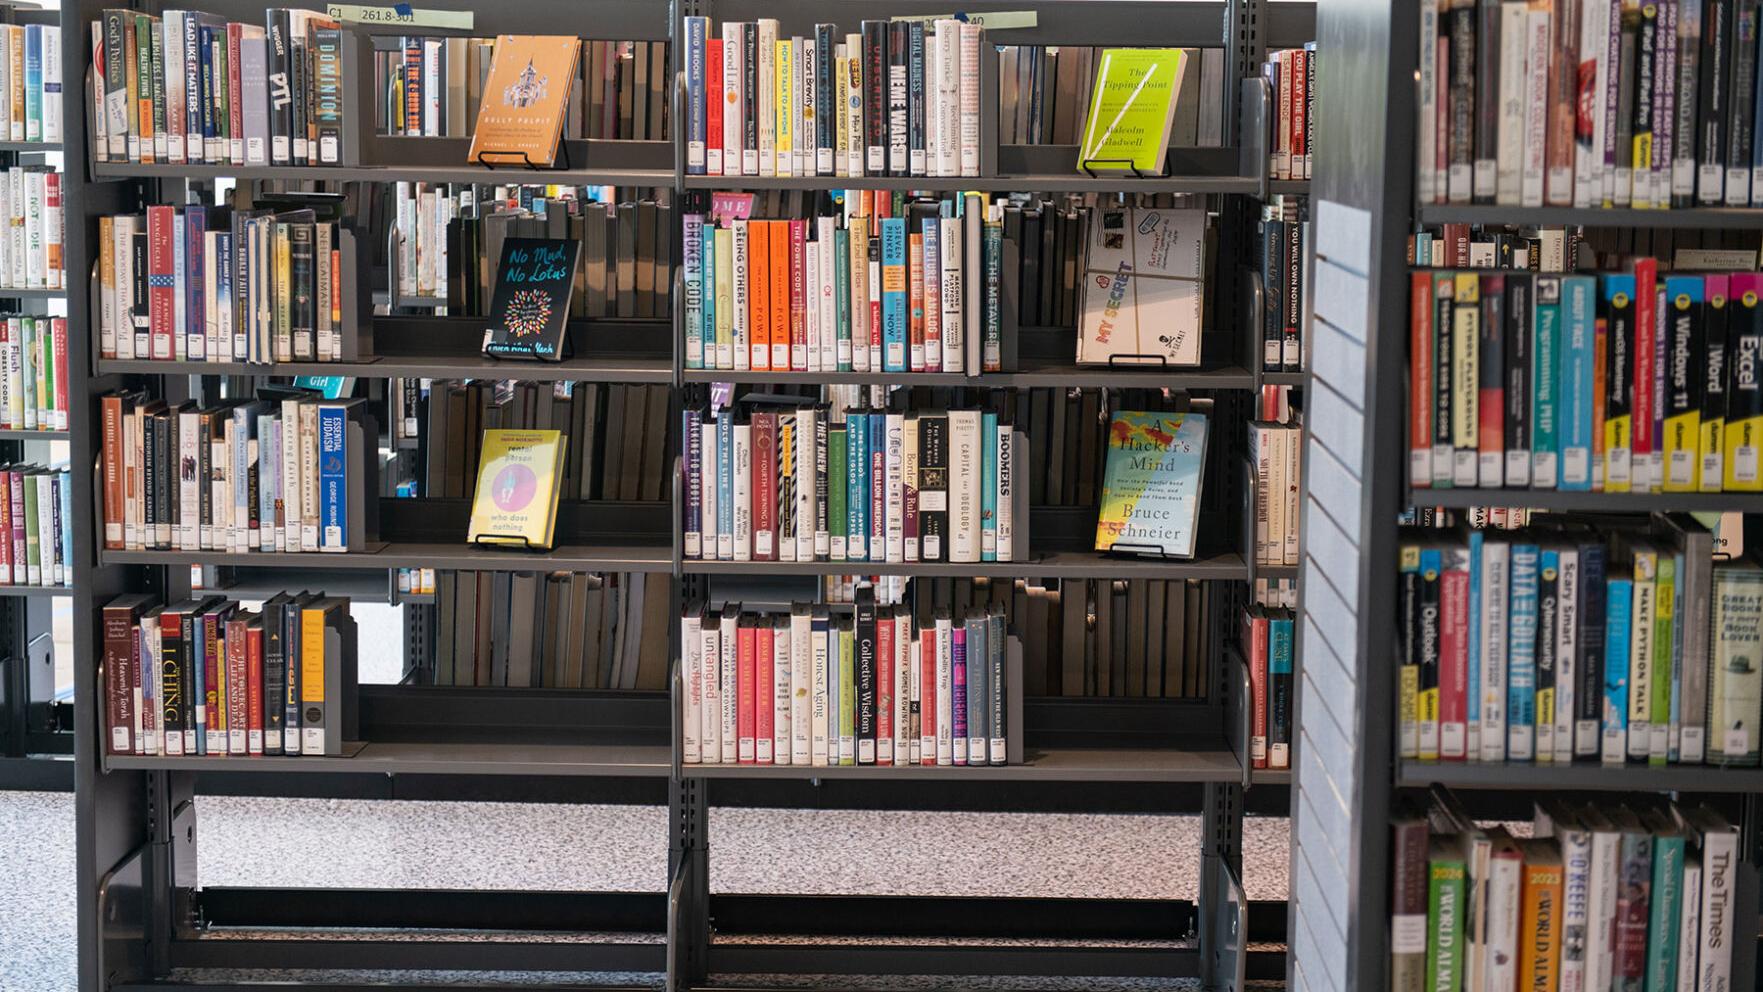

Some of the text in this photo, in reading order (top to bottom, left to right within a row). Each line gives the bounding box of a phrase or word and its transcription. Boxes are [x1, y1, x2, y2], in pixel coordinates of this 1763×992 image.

[272, 25, 284, 56] WIGGER
[329, 8, 342, 18] C1
[912, 27, 921, 55] DIGITAL
[109, 16, 121, 83] God's Politics
[186, 18, 198, 112] LEAD LIKE IT MATTERS
[726, 40, 737, 92] Good Life
[912, 57, 922, 92] MADNESS
[1639, 26, 1652, 126] iPad and iPad Pro
[269, 72, 291, 110] PTL
[320, 44, 336, 120] DOMINION
[804, 48, 814, 108] Smart Brevity
[890, 65, 906, 107] MEME
[1104, 81, 1141, 91] Tipping
[1102, 138, 1142, 146] Gladwell
[319, 230, 328, 309] NEIL GAIMAN
[506, 264, 566, 282] No Lotus
[510, 244, 566, 264] No Mud,
[686, 222, 701, 314] BROKEN CODE
[736, 226, 745, 305] SEEING OTHERS
[926, 224, 938, 333] THE FUTURE IS ANALOG
[989, 260, 998, 343] THE METAVER
[1096, 260, 1132, 344] MY SECRET
[1572, 285, 1584, 349] ABOUT FACE
[11, 345, 20, 372] Flush
[1538, 310, 1554, 433] Programming PHP
[1613, 320, 1626, 404] macOS Monterey
[1654, 292, 1666, 420] WINDOWS 11 FOR SENIORS
[1674, 317, 1691, 408] Windows 11
[1708, 349, 1723, 393] Word
[1738, 335, 1759, 390] Excel
[323, 416, 332, 452] JUDAISM
[333, 417, 341, 452] ESSENTIAL
[817, 420, 826, 444] THEY
[1121, 437, 1190, 453] Hacker's
[1152, 419, 1162, 432] A
[690, 417, 699, 507] TALKING TO ROBOTS
[817, 446, 827, 473] KNEW
[906, 453, 915, 488] Border
[1000, 434, 1009, 496] BOOMERS
[1129, 456, 1175, 472] Mind
[906, 498, 915, 518] Rule
[1108, 523, 1181, 540] Schneier
[1122, 504, 1170, 519] Bruce
[1513, 553, 1536, 596] DATA
[1562, 563, 1576, 645] Scary Smart
[1721, 605, 1761, 613] BOOKS
[1424, 607, 1437, 663] Outlook
[1511, 615, 1533, 688] GOLIATH
[1540, 596, 1554, 670] Cybersecurity
[1636, 587, 1649, 715] MAKE PYTHON TALK
[1720, 633, 1760, 641] LOVER
[118, 658, 129, 719] Heavenly Torah
[162, 660, 178, 722] CHING
[703, 636, 717, 699] untangled
[814, 648, 825, 718] Honest Aging
[861, 639, 872, 733] Collective Wisdom
[1432, 868, 1465, 880] 2024
[1708, 851, 1730, 948] The Times
[1437, 892, 1455, 992] WORLD ALMA
